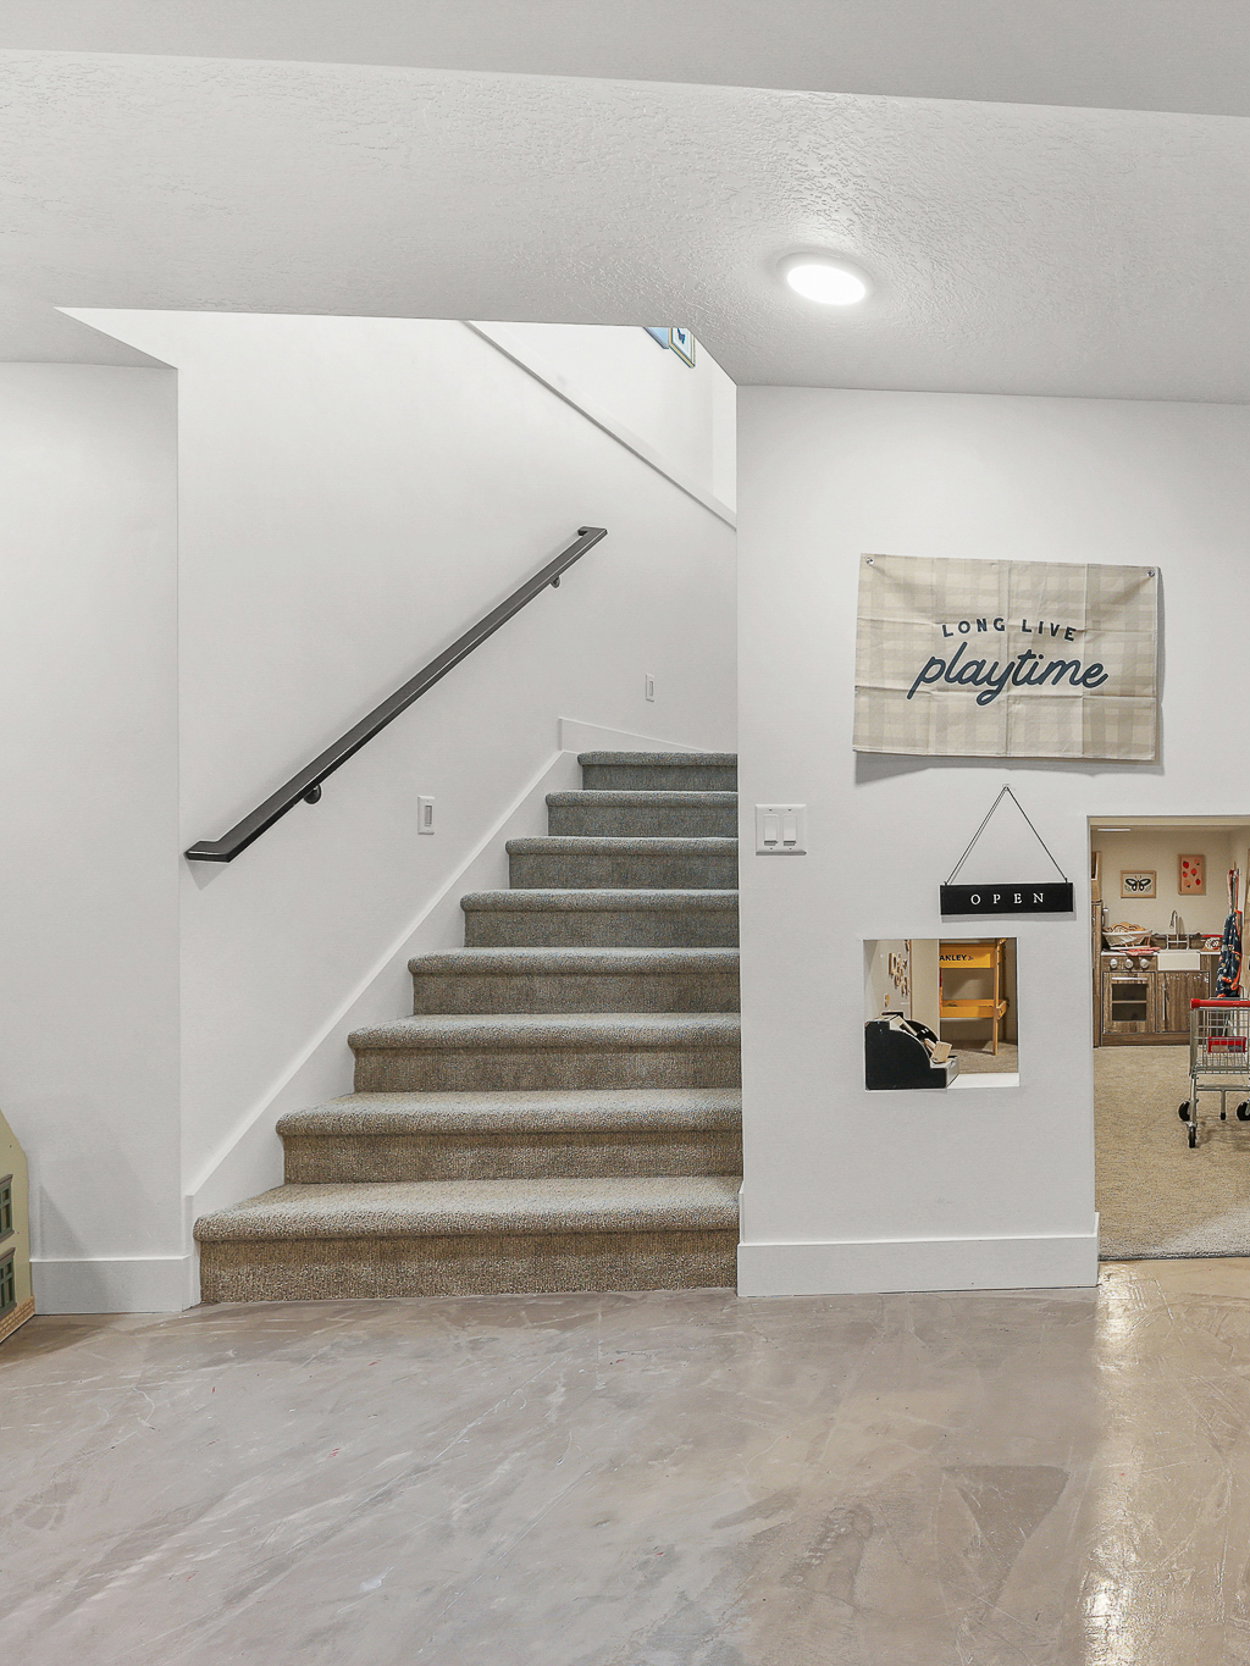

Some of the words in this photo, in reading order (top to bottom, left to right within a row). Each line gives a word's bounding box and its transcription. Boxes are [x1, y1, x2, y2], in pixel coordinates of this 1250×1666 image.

[942, 617, 1006, 638] LONG
[1021, 618, 1077, 642] LIVE
[906, 641, 1109, 706] playtime
[970, 892, 1045, 906] OPEN
